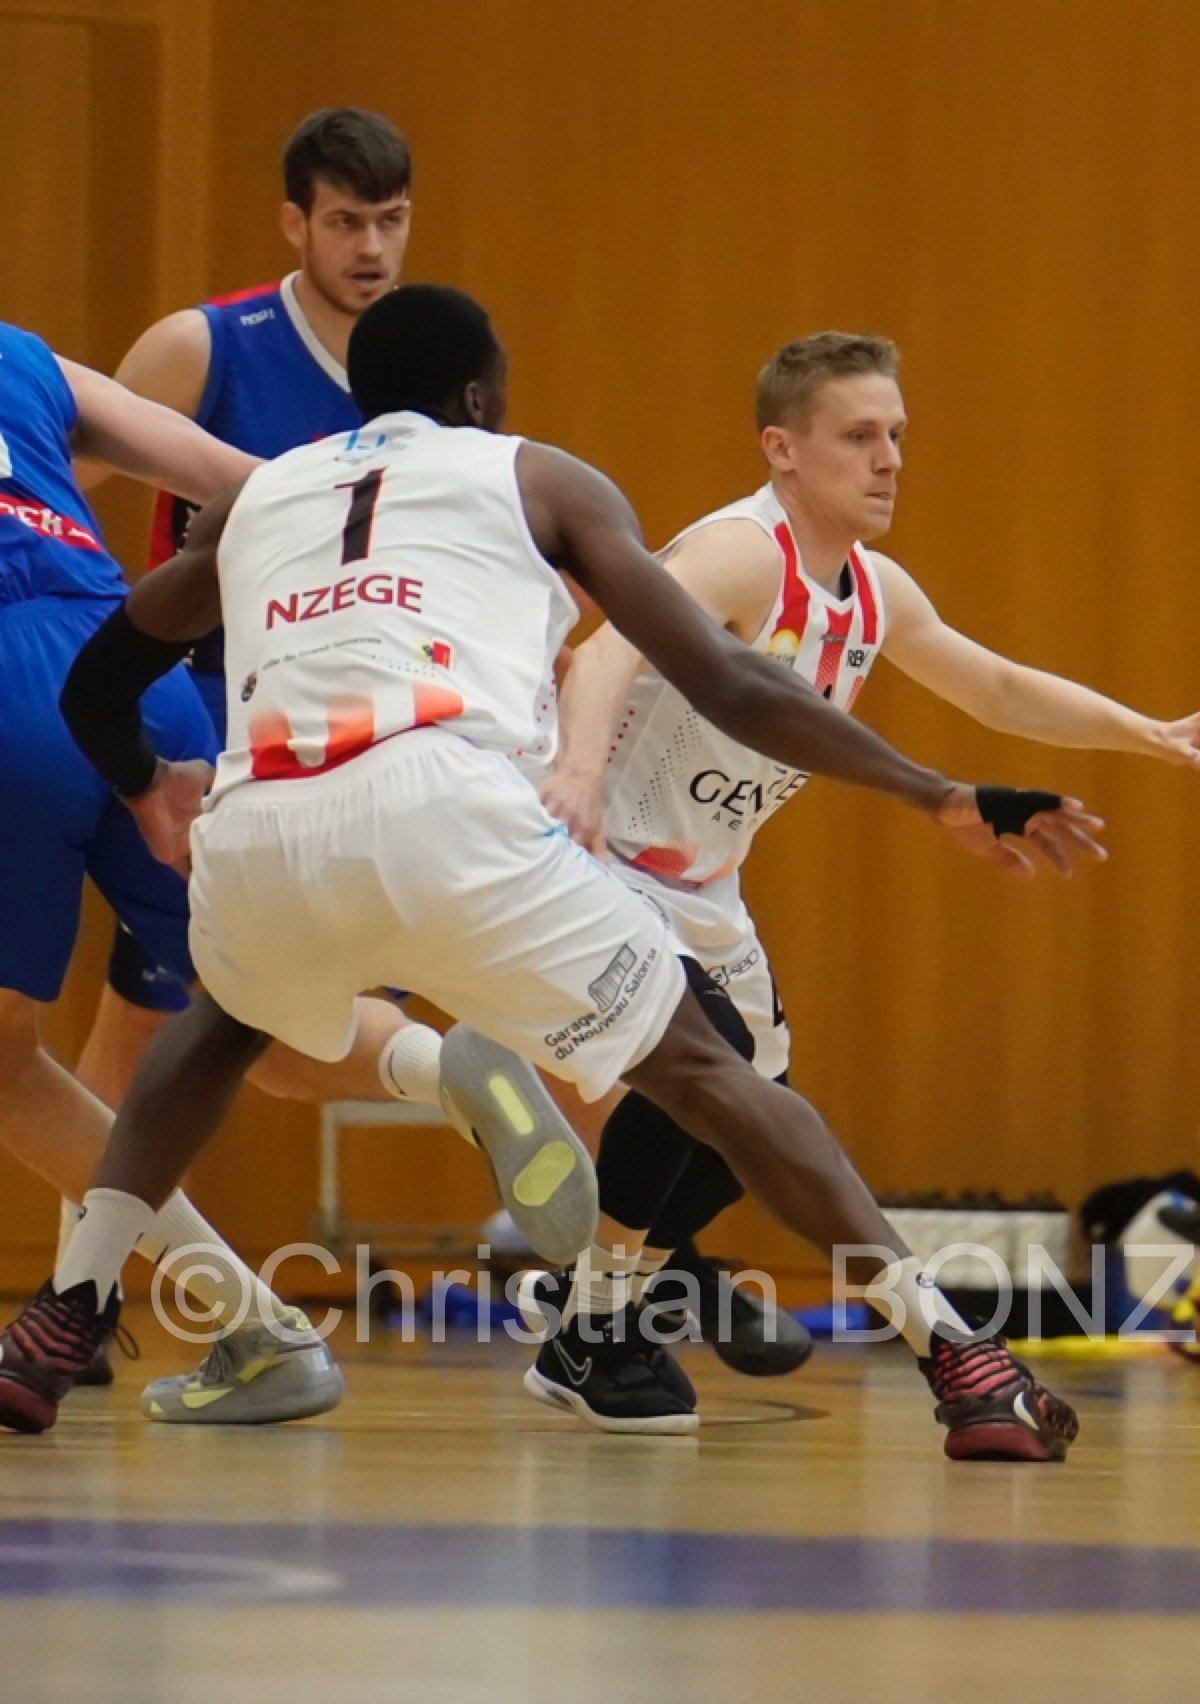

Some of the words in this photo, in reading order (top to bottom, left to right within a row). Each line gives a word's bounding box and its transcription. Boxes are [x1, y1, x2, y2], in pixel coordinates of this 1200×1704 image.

[334, 466, 388, 566] 1
[265, 573, 424, 631] NZEGE
[544, 1011, 597, 1047] Garage
[555, 1043, 575, 1060] du
[571, 997, 629, 1046] Nouveau
[624, 960, 651, 998] Salon
